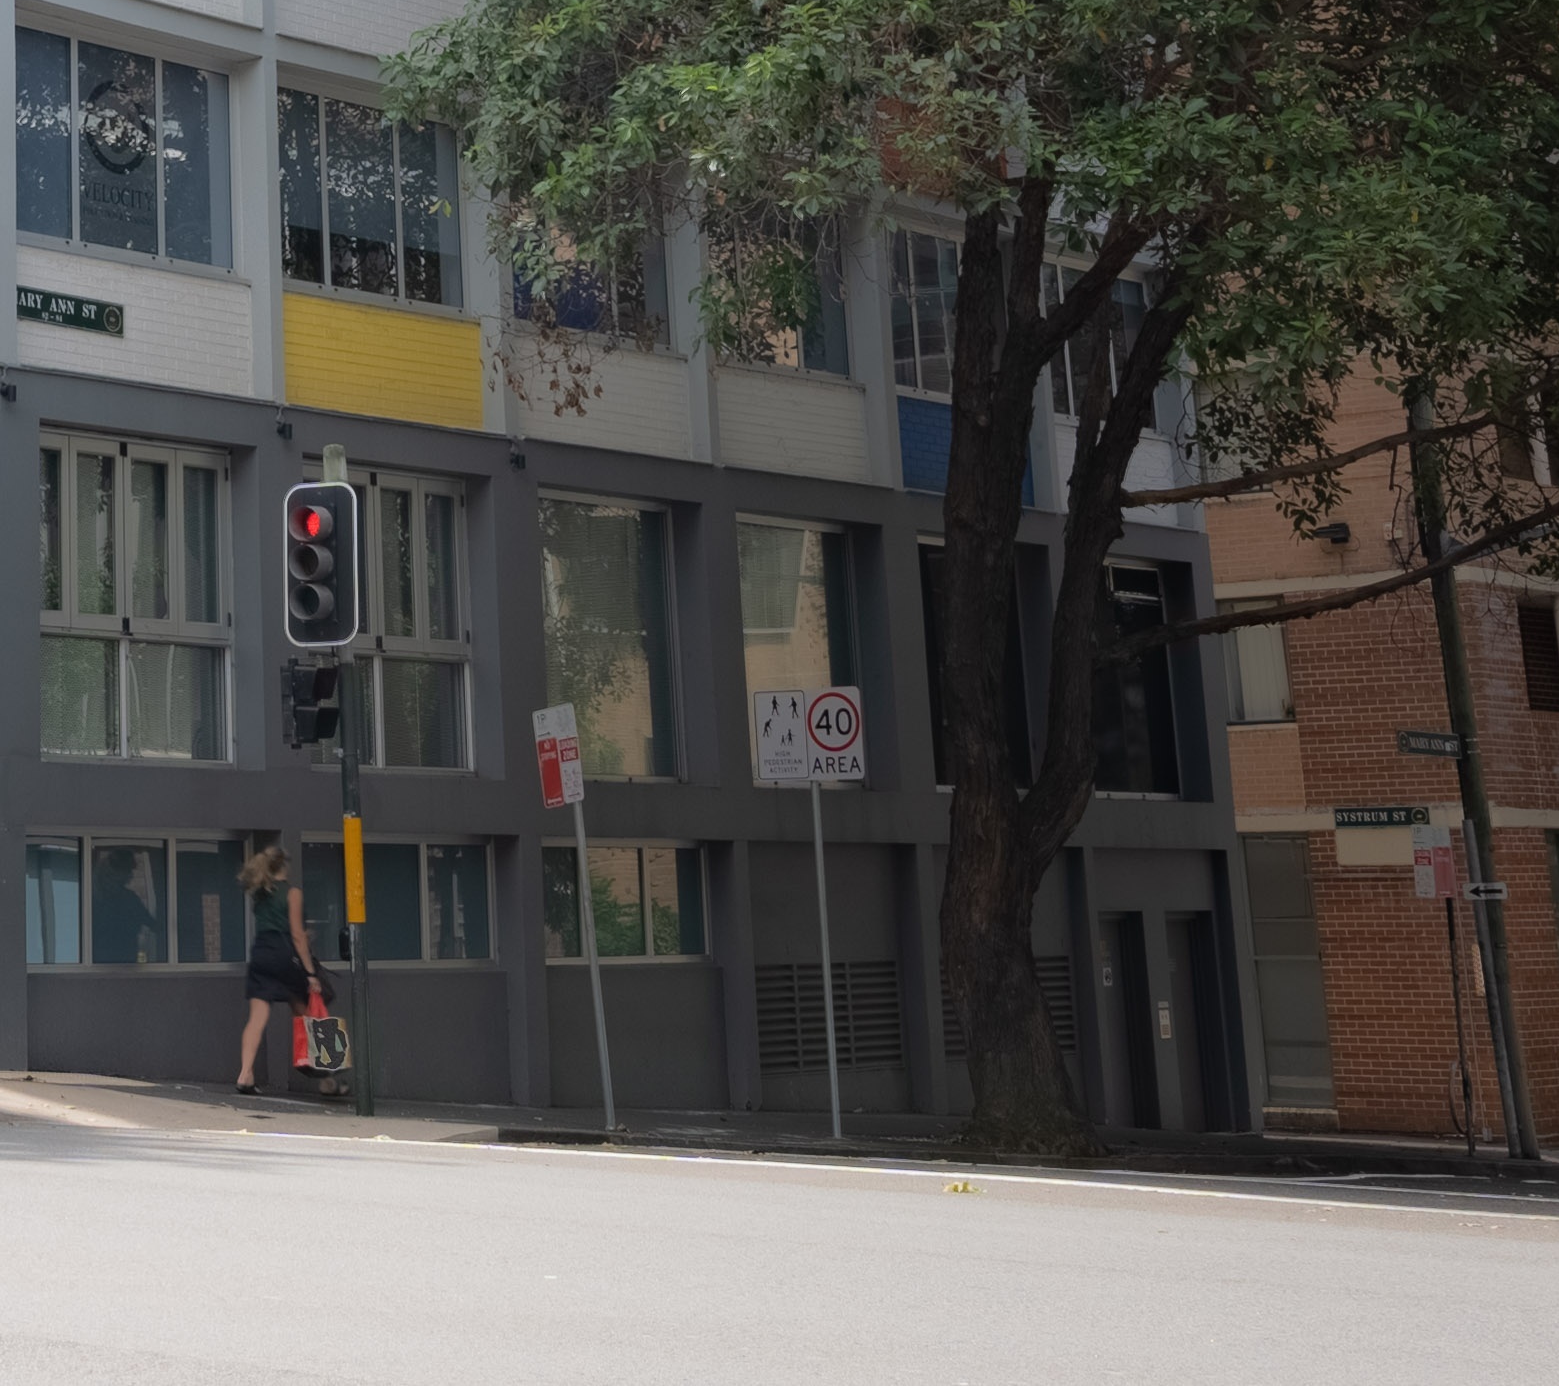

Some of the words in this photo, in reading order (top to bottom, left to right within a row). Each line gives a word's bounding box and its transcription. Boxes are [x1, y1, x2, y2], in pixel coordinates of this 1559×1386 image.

[83, 182, 153, 211] VELOCITY
[17, 291, 43, 310] ARY
[49, 297, 75, 315] ANN
[82, 303, 97, 320] ST
[815, 708, 852, 736] 40
[764, 758, 802, 766] PEDESTRIAN
[812, 756, 861, 774] AREA
[1336, 811, 1388, 822] SYSTRUM
[1392, 810, 1406, 822] ST
